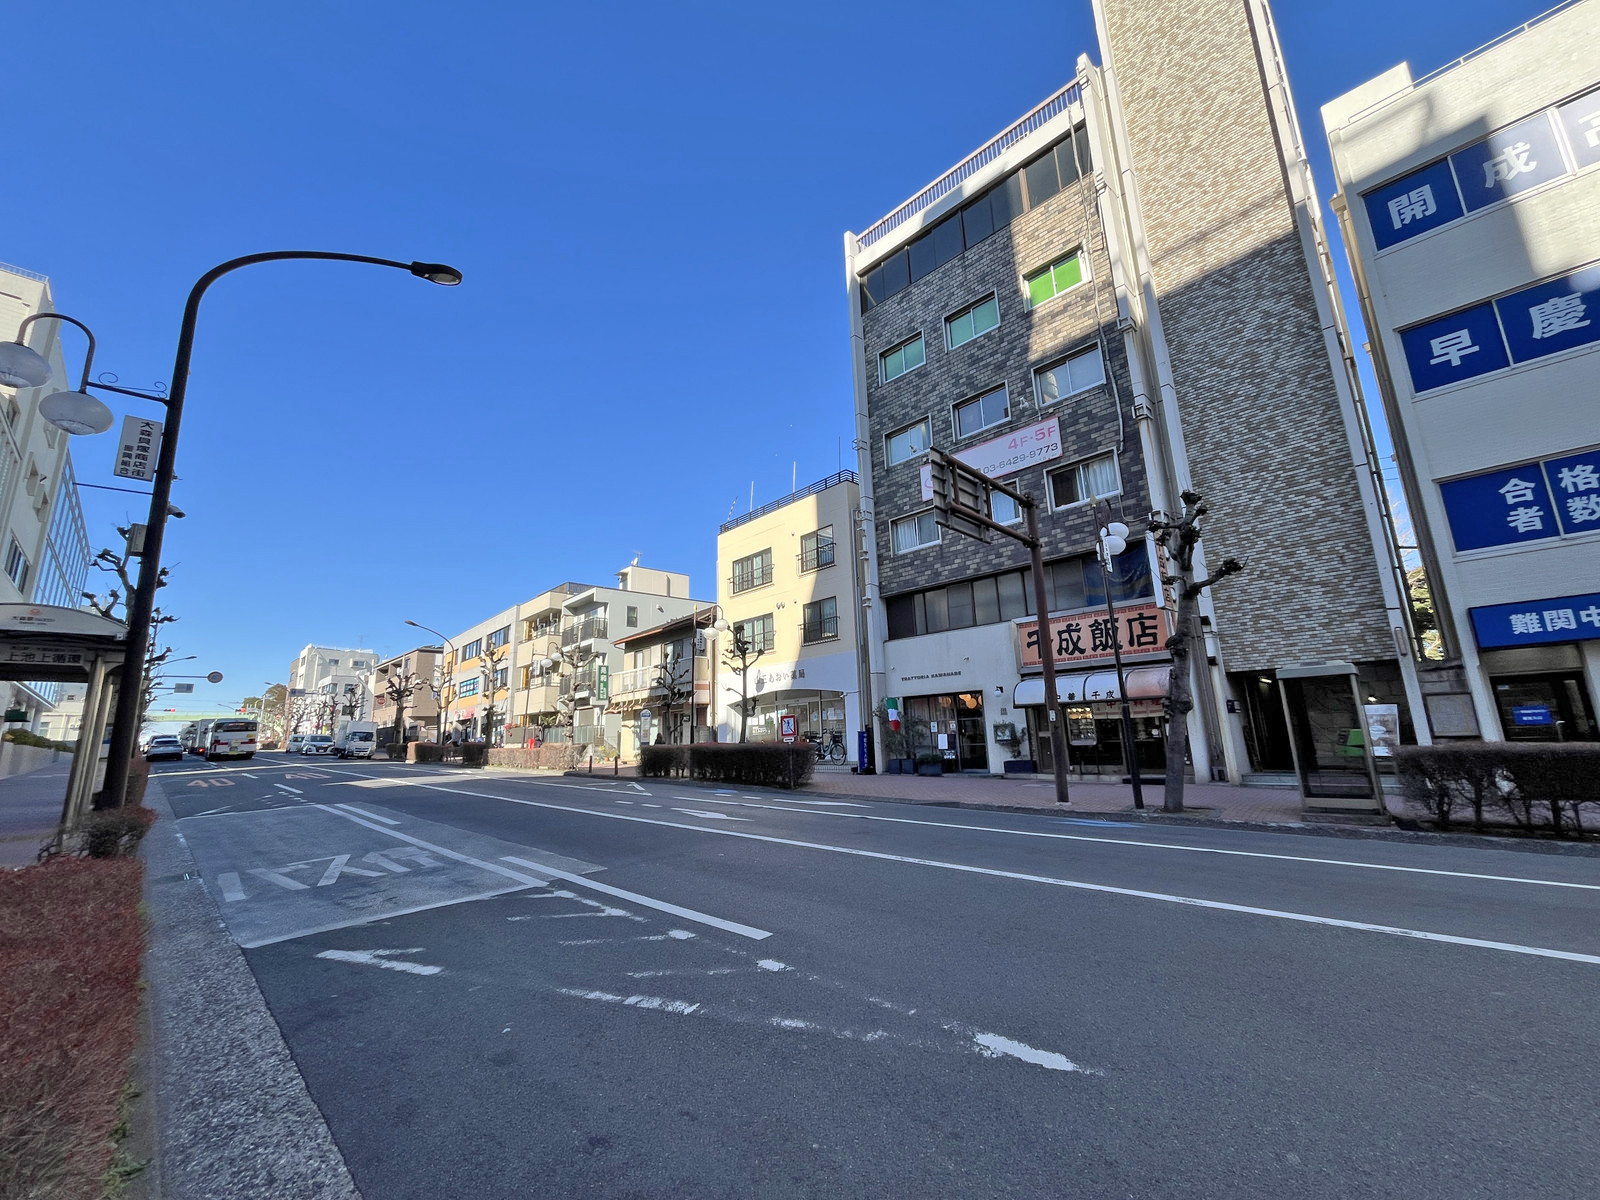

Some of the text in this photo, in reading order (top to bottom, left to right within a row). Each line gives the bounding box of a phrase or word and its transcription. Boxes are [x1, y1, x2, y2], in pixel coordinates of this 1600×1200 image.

[1429, 291, 1591, 367] 早慶
[982, 442, 1059, 475] 03-6429-9773
[1498, 464, 1600, 505] 合格
[1506, 493, 1600, 534] 者数
[901, 674, 930, 682] TRATTORIA
[187, 778, 236, 788] 40
